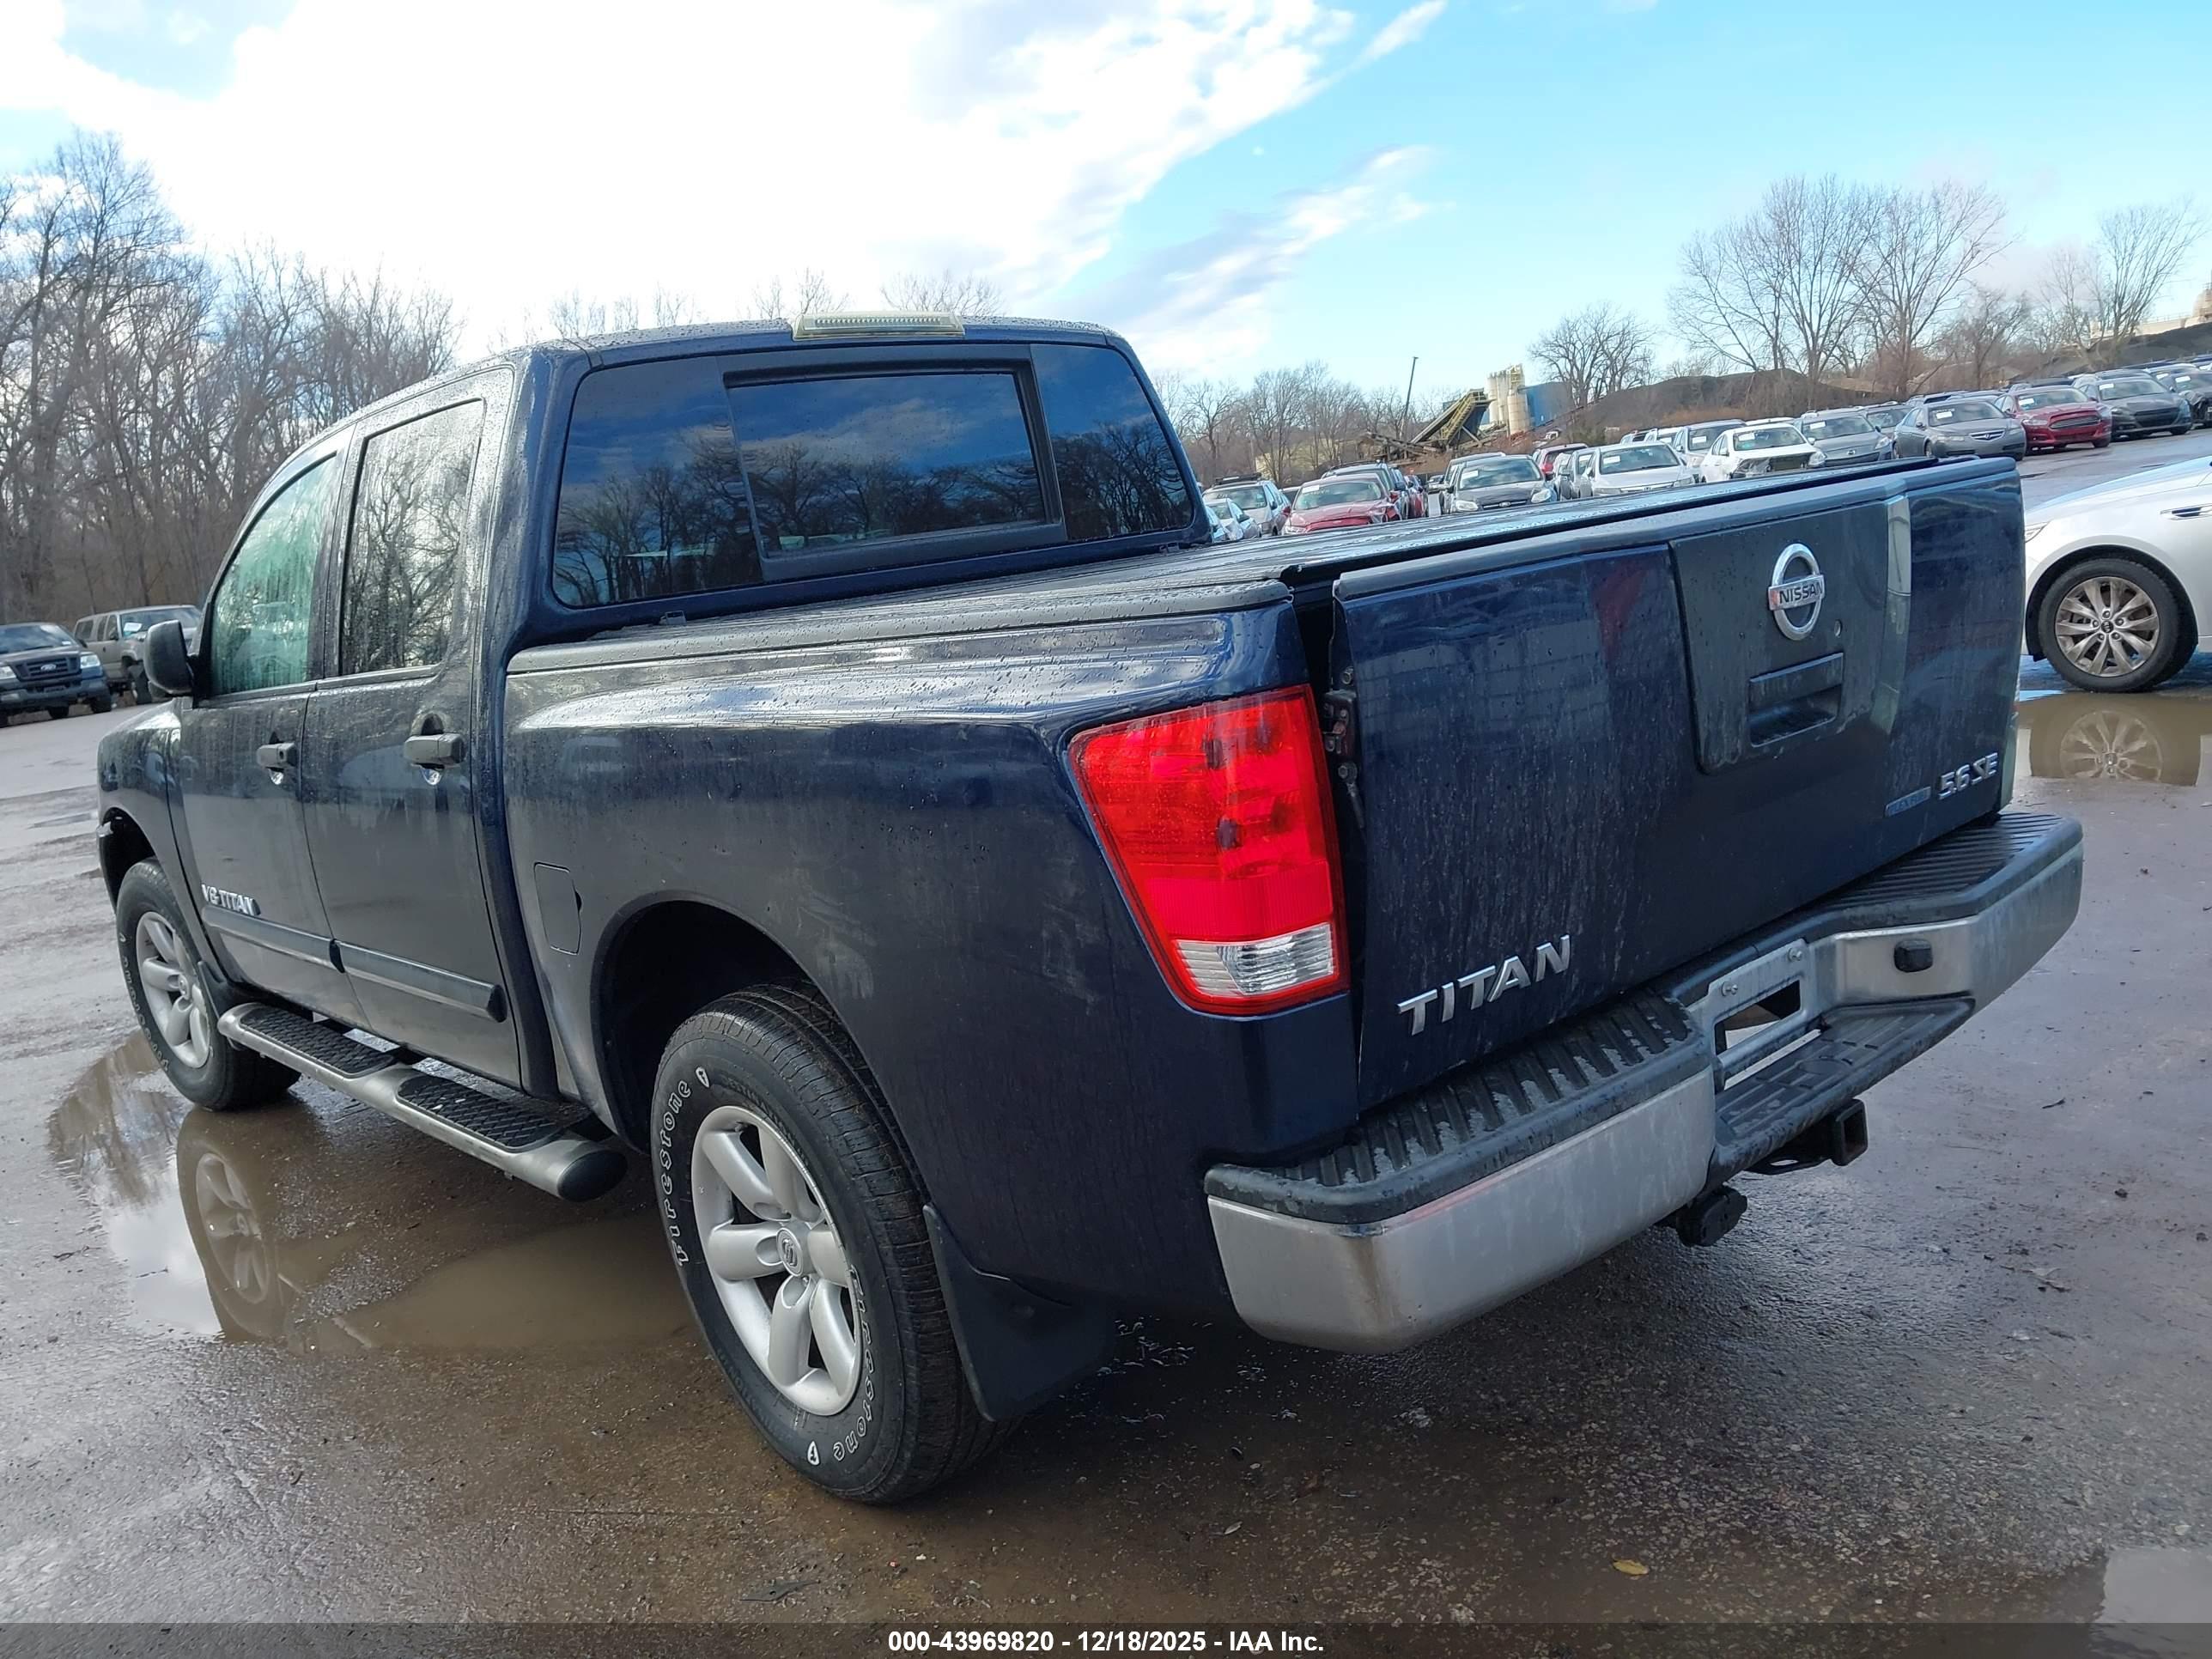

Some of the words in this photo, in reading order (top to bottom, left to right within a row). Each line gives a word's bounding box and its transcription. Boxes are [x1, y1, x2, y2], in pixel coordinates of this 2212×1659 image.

[1779, 581, 1824, 604] NISSAN
[1972, 752, 1998, 785] SE
[218, 889, 258, 916] TITAN
[1396, 934, 1571, 1036] TITAN
